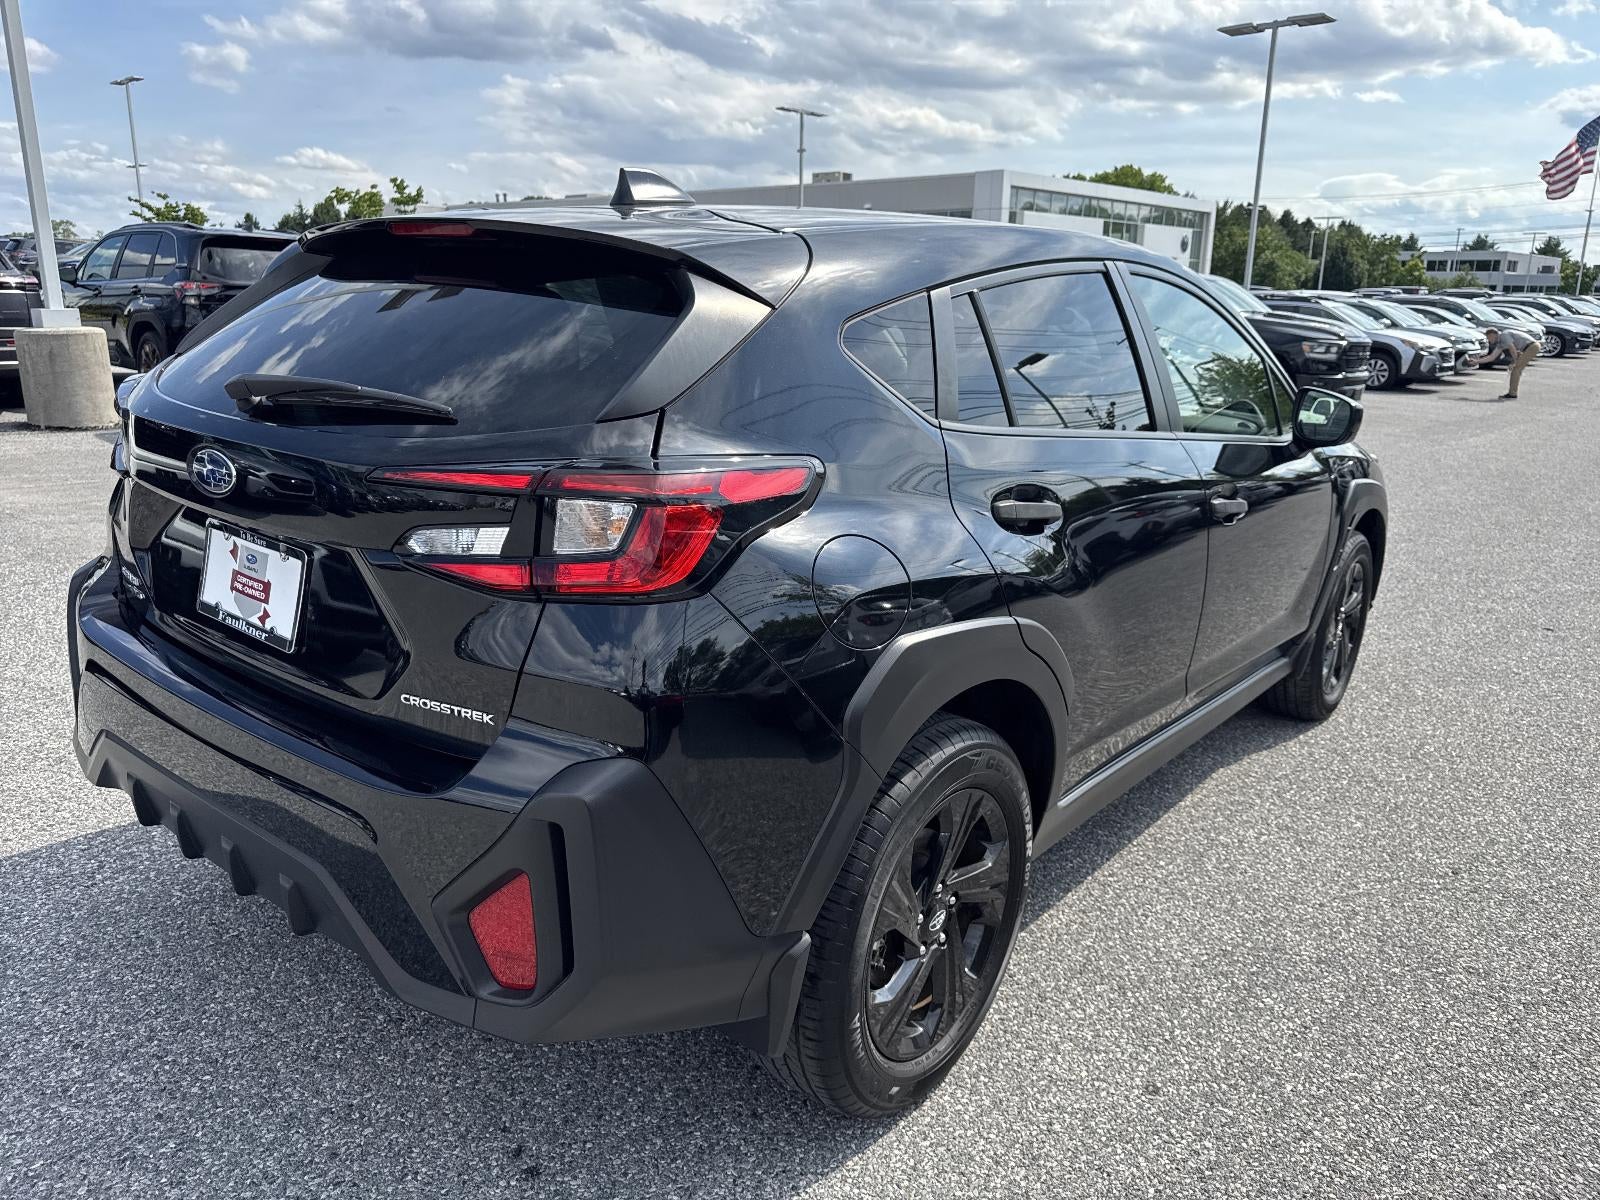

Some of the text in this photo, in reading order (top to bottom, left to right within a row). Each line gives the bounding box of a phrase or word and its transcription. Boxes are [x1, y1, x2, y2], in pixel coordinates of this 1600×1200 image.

[254, 535, 267, 546] Sure
[232, 581, 266, 600] PRE-OWNED
[236, 574, 264, 591] CERTIFIED
[218, 611, 269, 641] Faulkner
[400, 693, 495, 726] CROSSTREK
